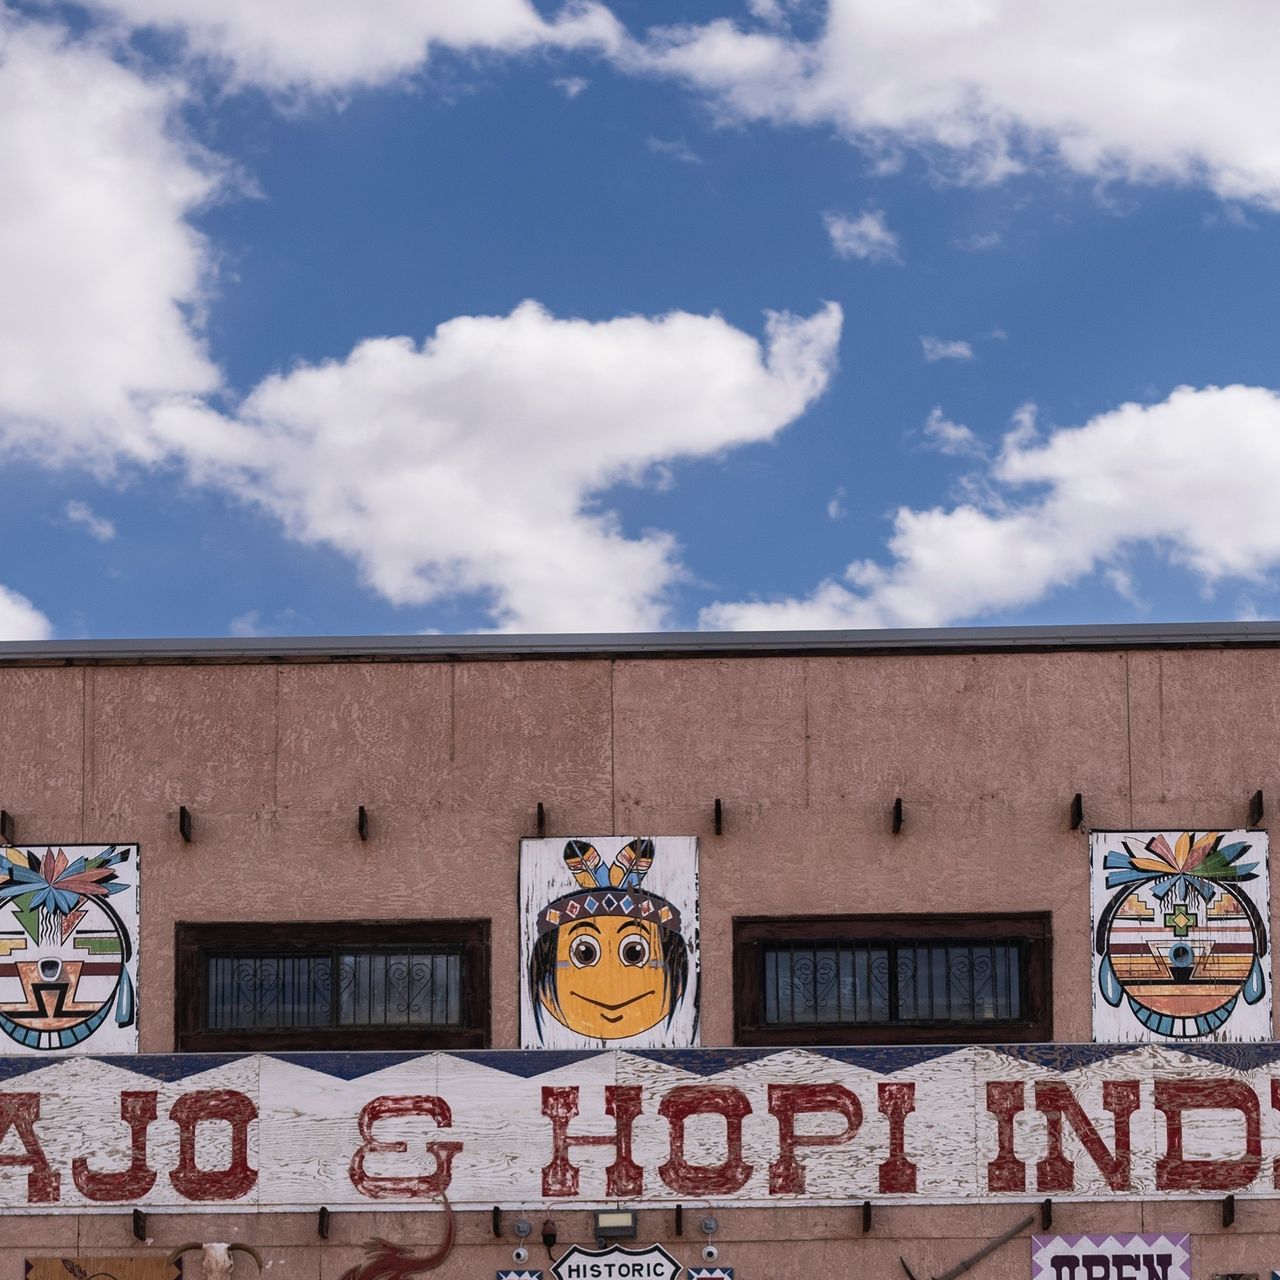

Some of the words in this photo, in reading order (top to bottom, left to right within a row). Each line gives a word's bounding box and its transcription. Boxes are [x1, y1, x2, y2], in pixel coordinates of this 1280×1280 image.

[349, 1093, 464, 1198] &
[541, 1081, 917, 1198] HOPI
[568, 1262, 665, 1279] HISTORIC
